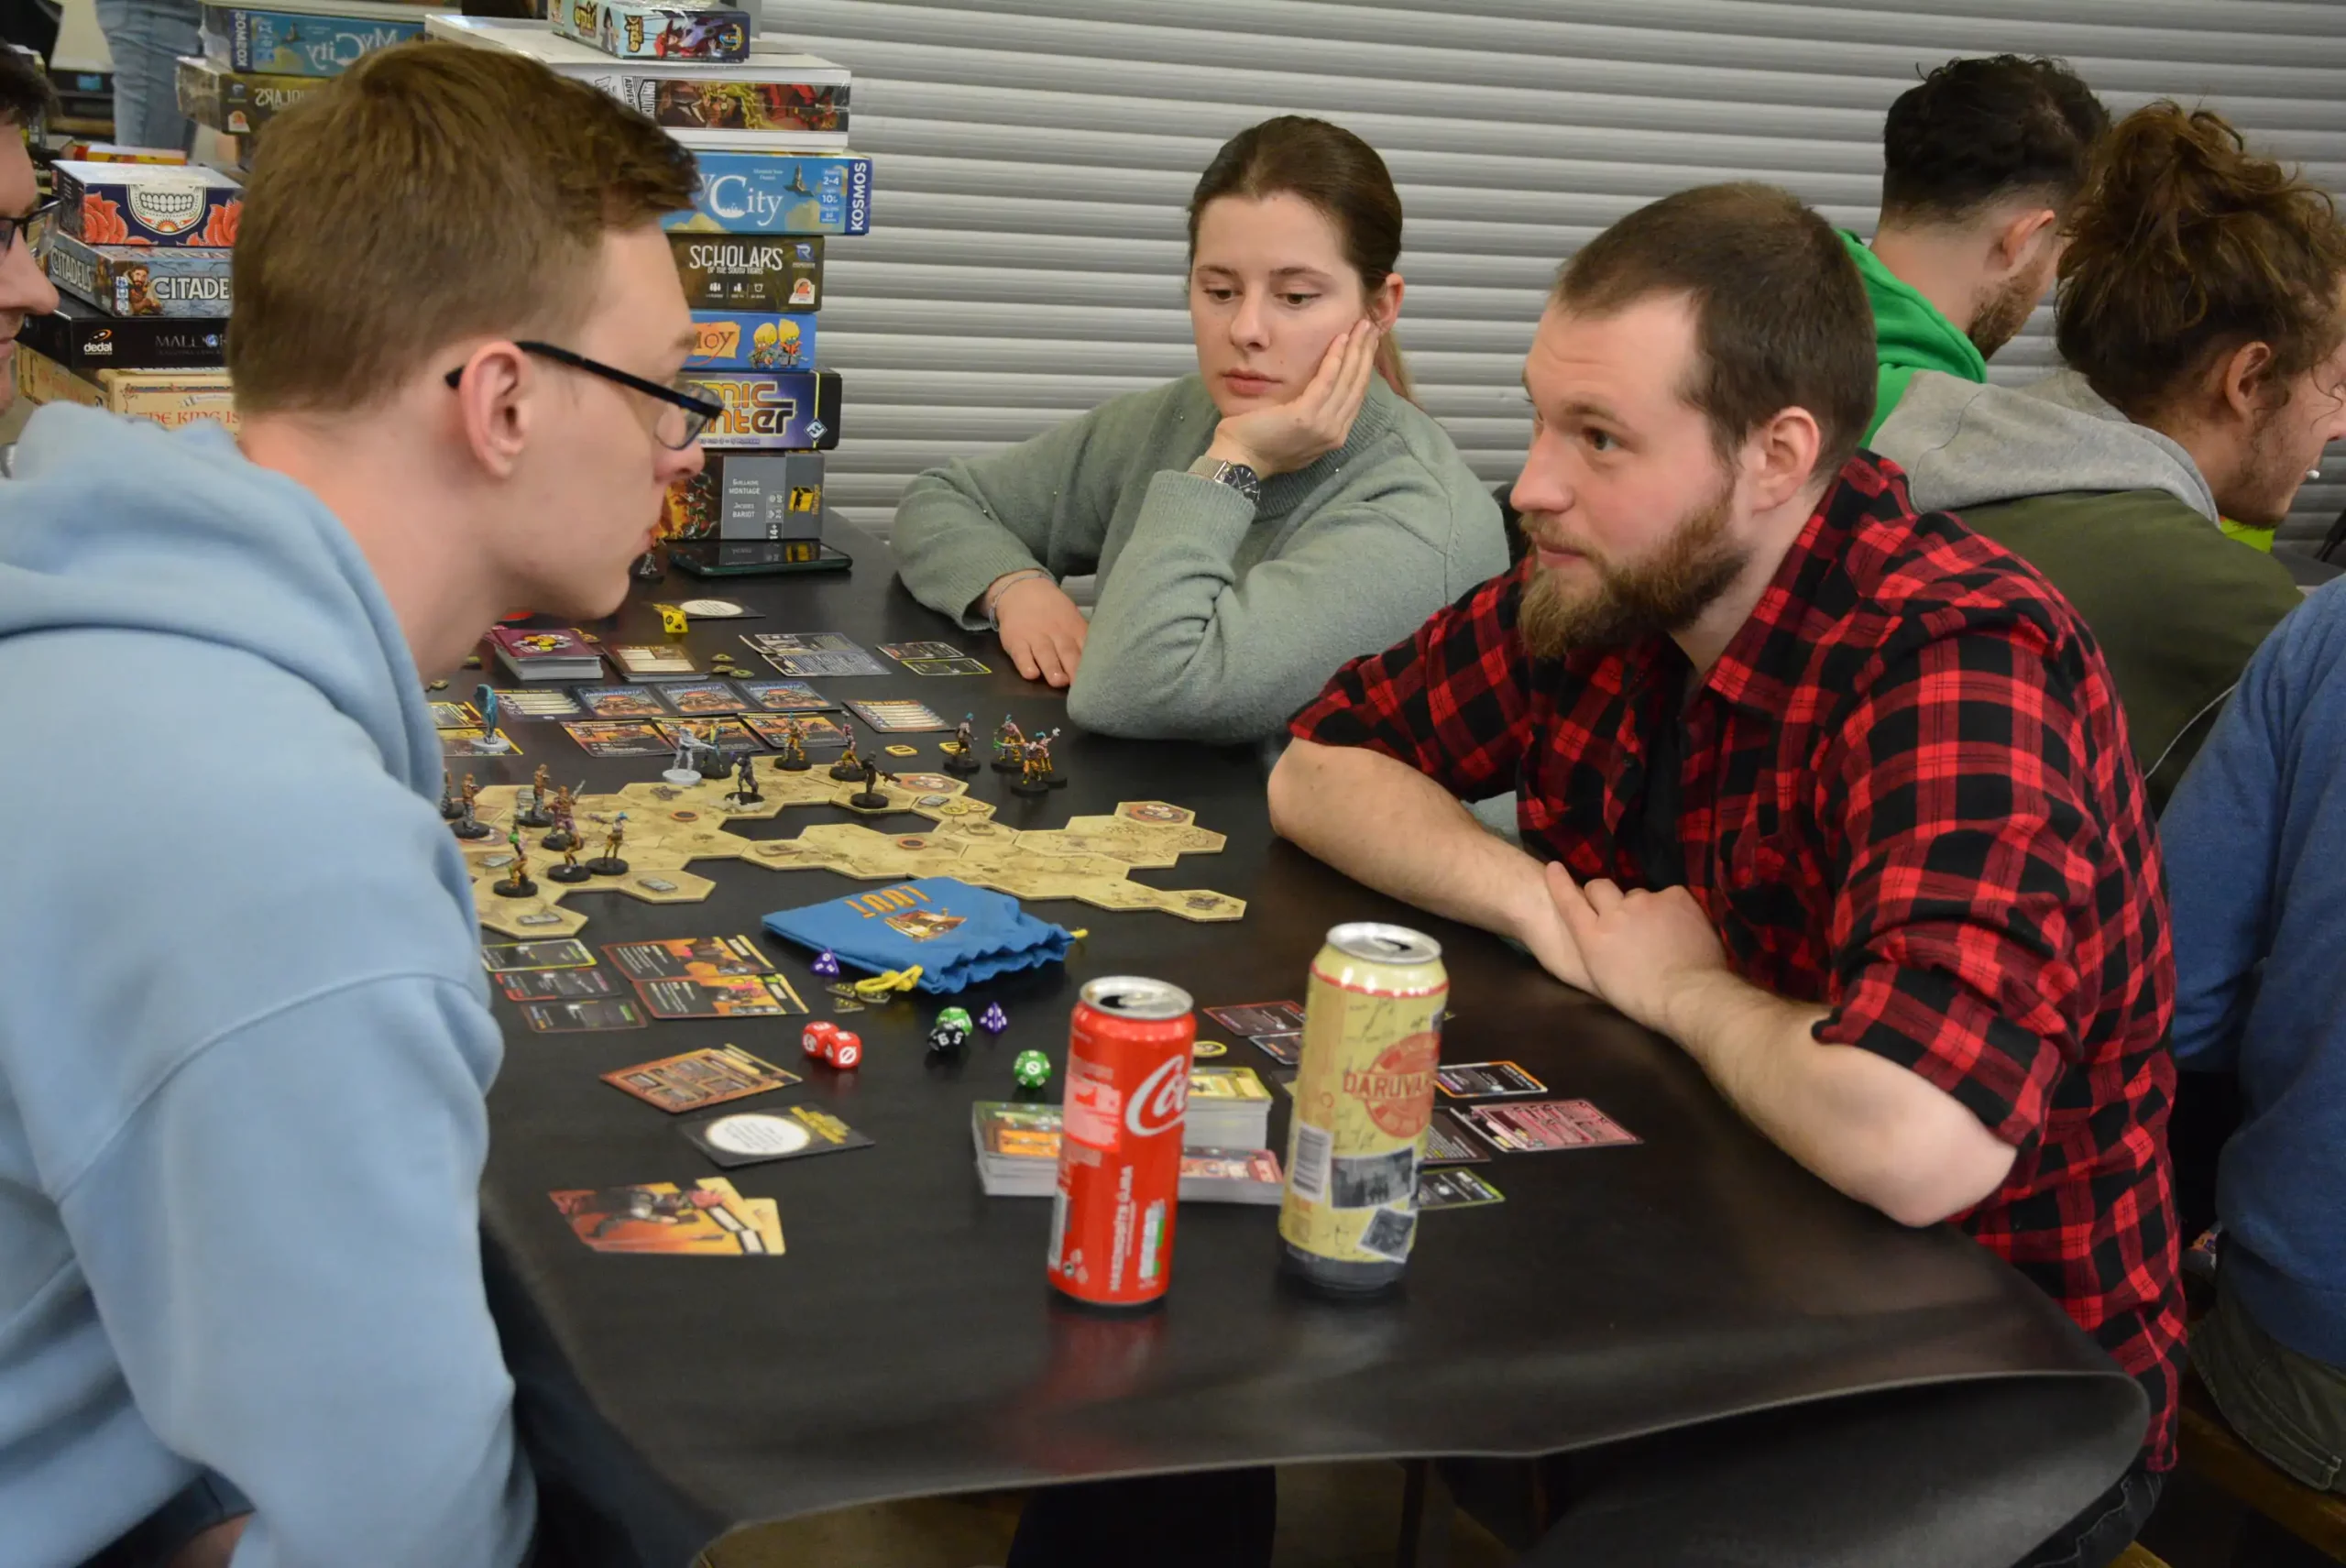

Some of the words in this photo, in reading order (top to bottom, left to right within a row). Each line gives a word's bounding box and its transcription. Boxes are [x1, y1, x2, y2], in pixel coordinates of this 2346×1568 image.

[710, 174, 784, 226] City
[850, 161, 867, 231] KOSMOS
[50, 246, 92, 293] CITADELS
[689, 245, 784, 270] SCHOLARS
[154, 276, 230, 301] CITADE
[83, 341, 113, 352] dedal
[843, 884, 933, 919] LOOT
